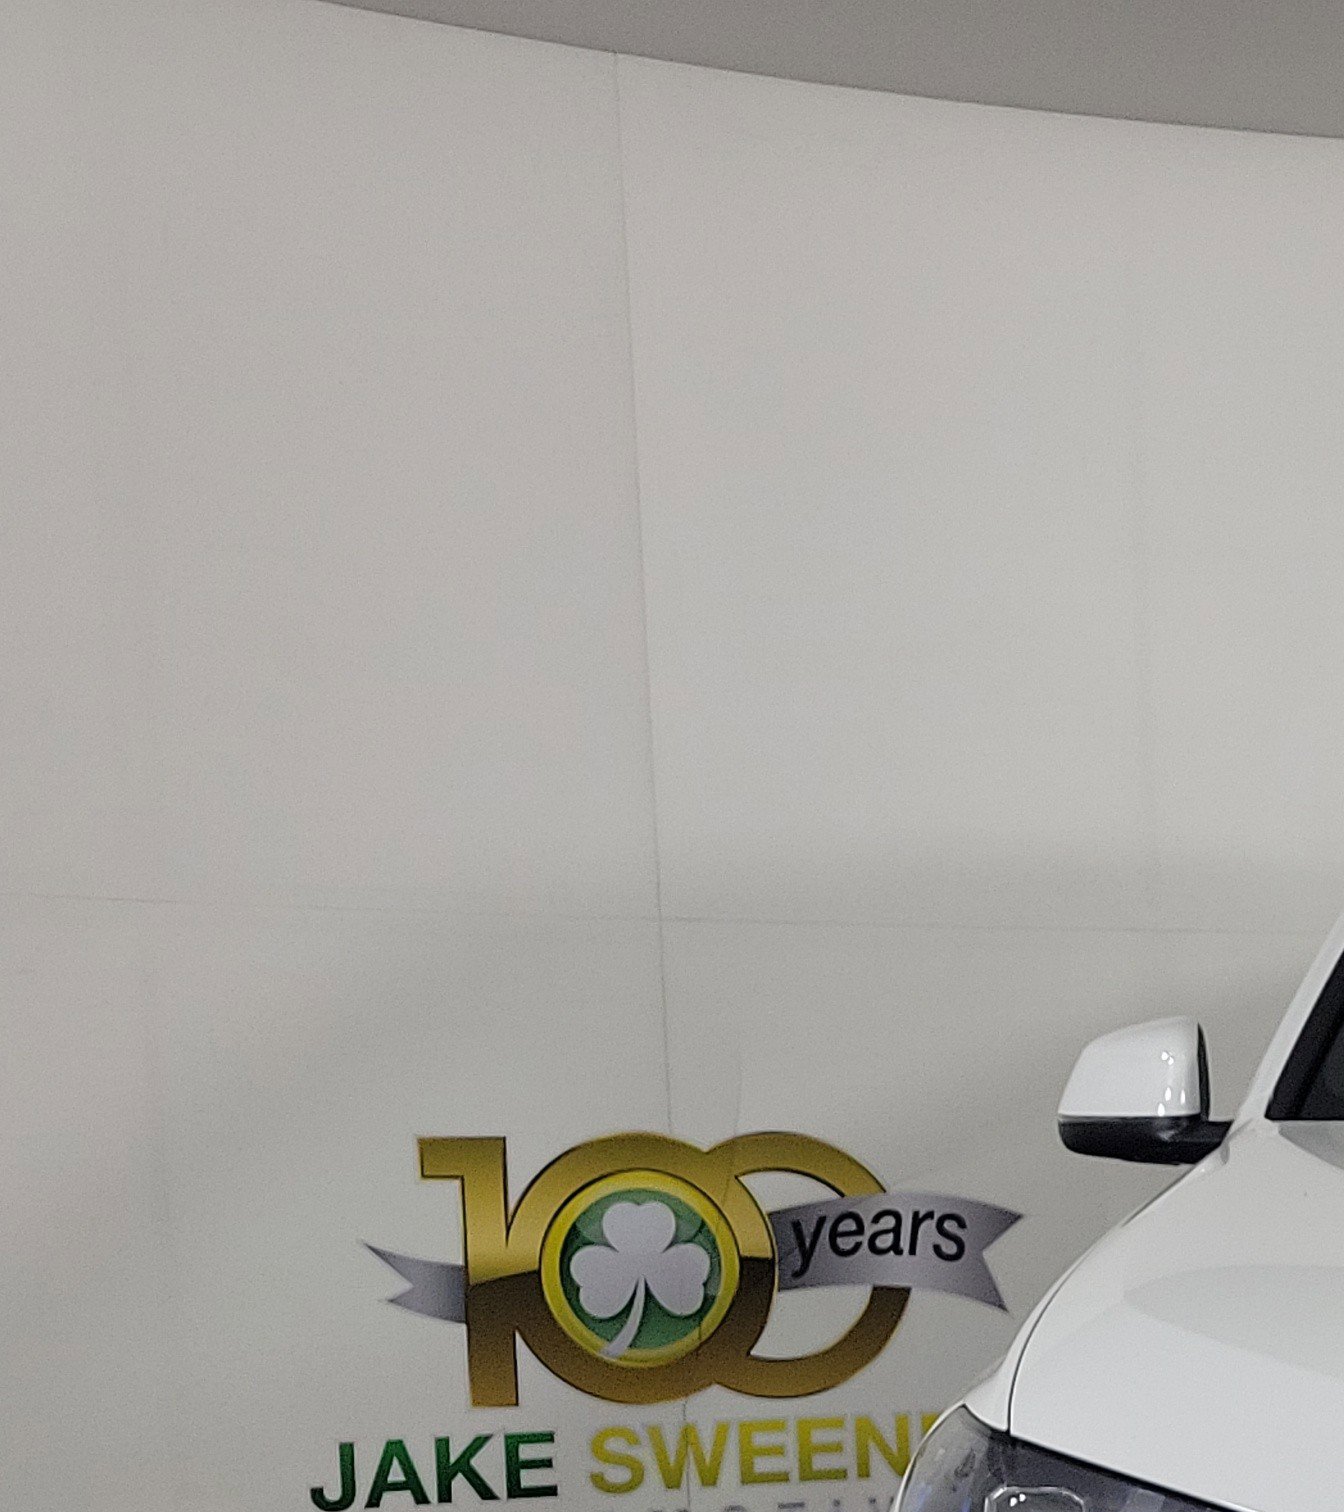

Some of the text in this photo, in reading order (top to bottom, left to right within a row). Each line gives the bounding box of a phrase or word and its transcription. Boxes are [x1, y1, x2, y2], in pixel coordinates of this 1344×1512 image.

[416, 1131, 968, 1407] 100 years
[310, 1412, 940, 1512] JAKE SWEEN
